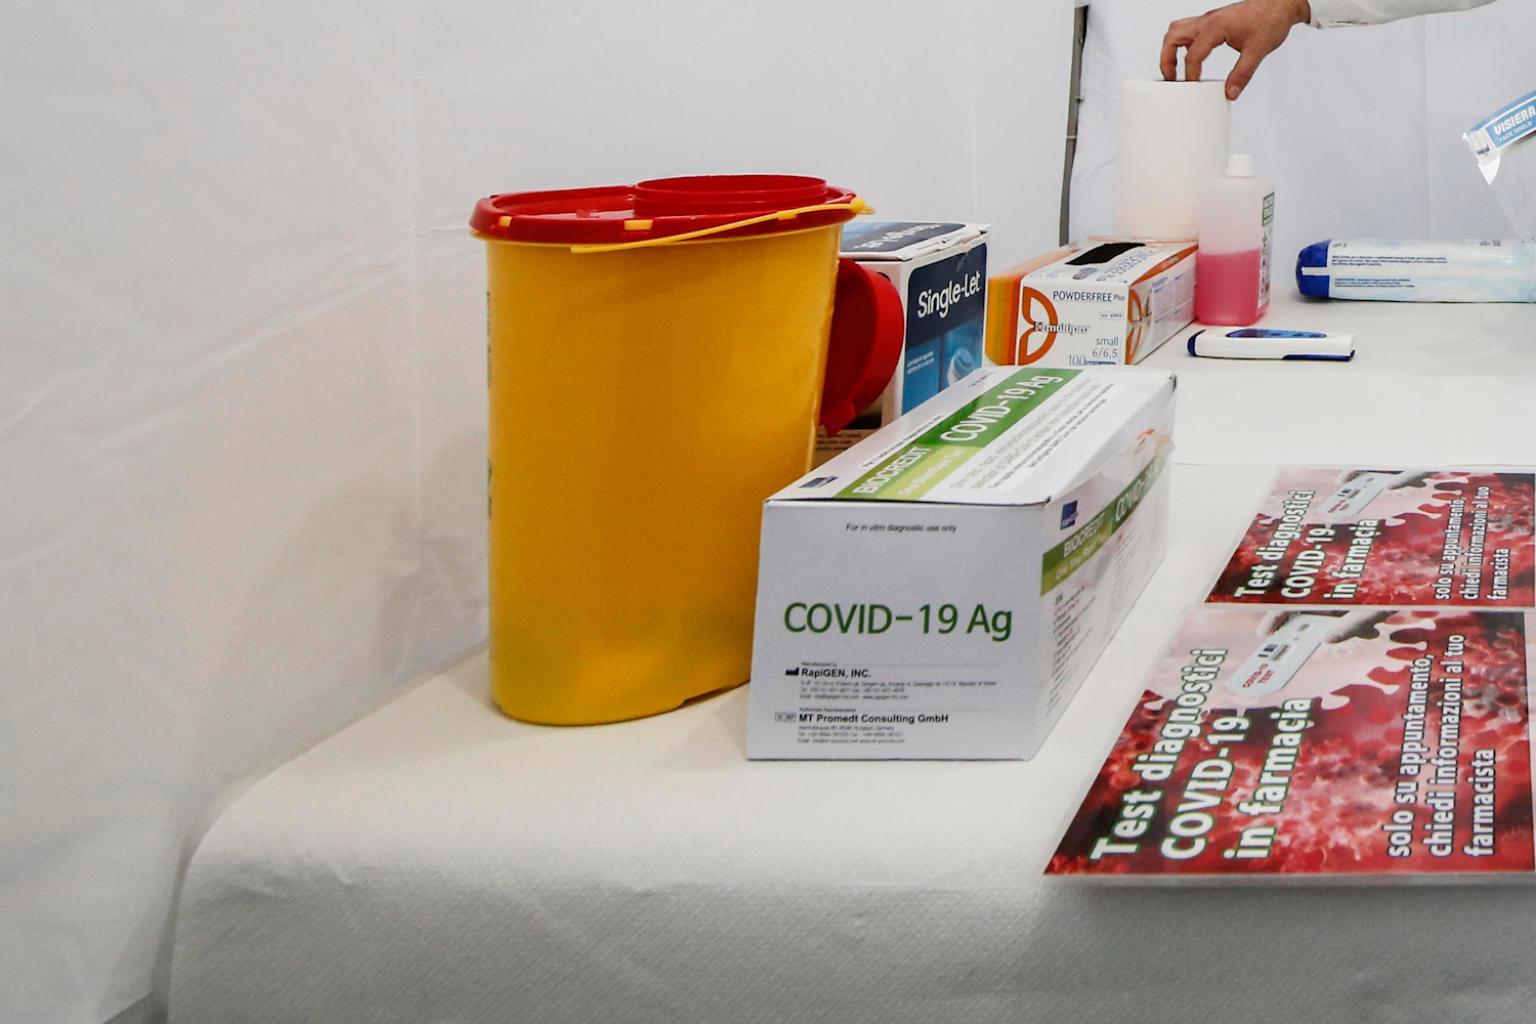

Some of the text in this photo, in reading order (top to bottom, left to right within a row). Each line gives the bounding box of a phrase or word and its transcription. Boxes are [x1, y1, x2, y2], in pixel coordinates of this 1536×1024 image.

[1494, 105, 1536, 135] VISIERA
[918, 271, 981, 318] Single-Let
[1052, 291, 1112, 302] POWDERFREE
[1068, 355, 1086, 365] 100
[1092, 348, 1117, 359] 6/6,5
[1096, 336, 1119, 346] small
[852, 447, 931, 495] BIOCREDIT
[940, 388, 1036, 442] COVID-19
[1016, 376, 1064, 388] Ag
[1474, 486, 1490, 499] tuo
[846, 523, 858, 531] For
[887, 524, 924, 533] diagnostic
[941, 524, 957, 533] only
[1234, 490, 1316, 597] Test diagnostici
[1432, 497, 1467, 600] solo su appuntamento,
[1464, 510, 1488, 567] informazioni
[1281, 528, 1336, 598] COVID-19
[1323, 520, 1379, 599] in farmacia
[1459, 569, 1481, 600] chiedi
[1486, 549, 1510, 600] farmacista
[784, 602, 1012, 642] COVID-19 Ag
[801, 668, 872, 679] RapiGEN, INC.
[816, 715, 858, 723] Promedt
[861, 714, 915, 724] Consulting
[918, 715, 949, 723] GmbH
[1089, 648, 1228, 860] Test diagnostici
[1383, 654, 1435, 857] solo su appuntamento,
[1423, 634, 1464, 857] chiedi informazioni al tuo
[1160, 716, 1250, 860] COVID-19
[1223, 698, 1314, 859] in farmacia
[1464, 749, 1496, 857] farmacista
